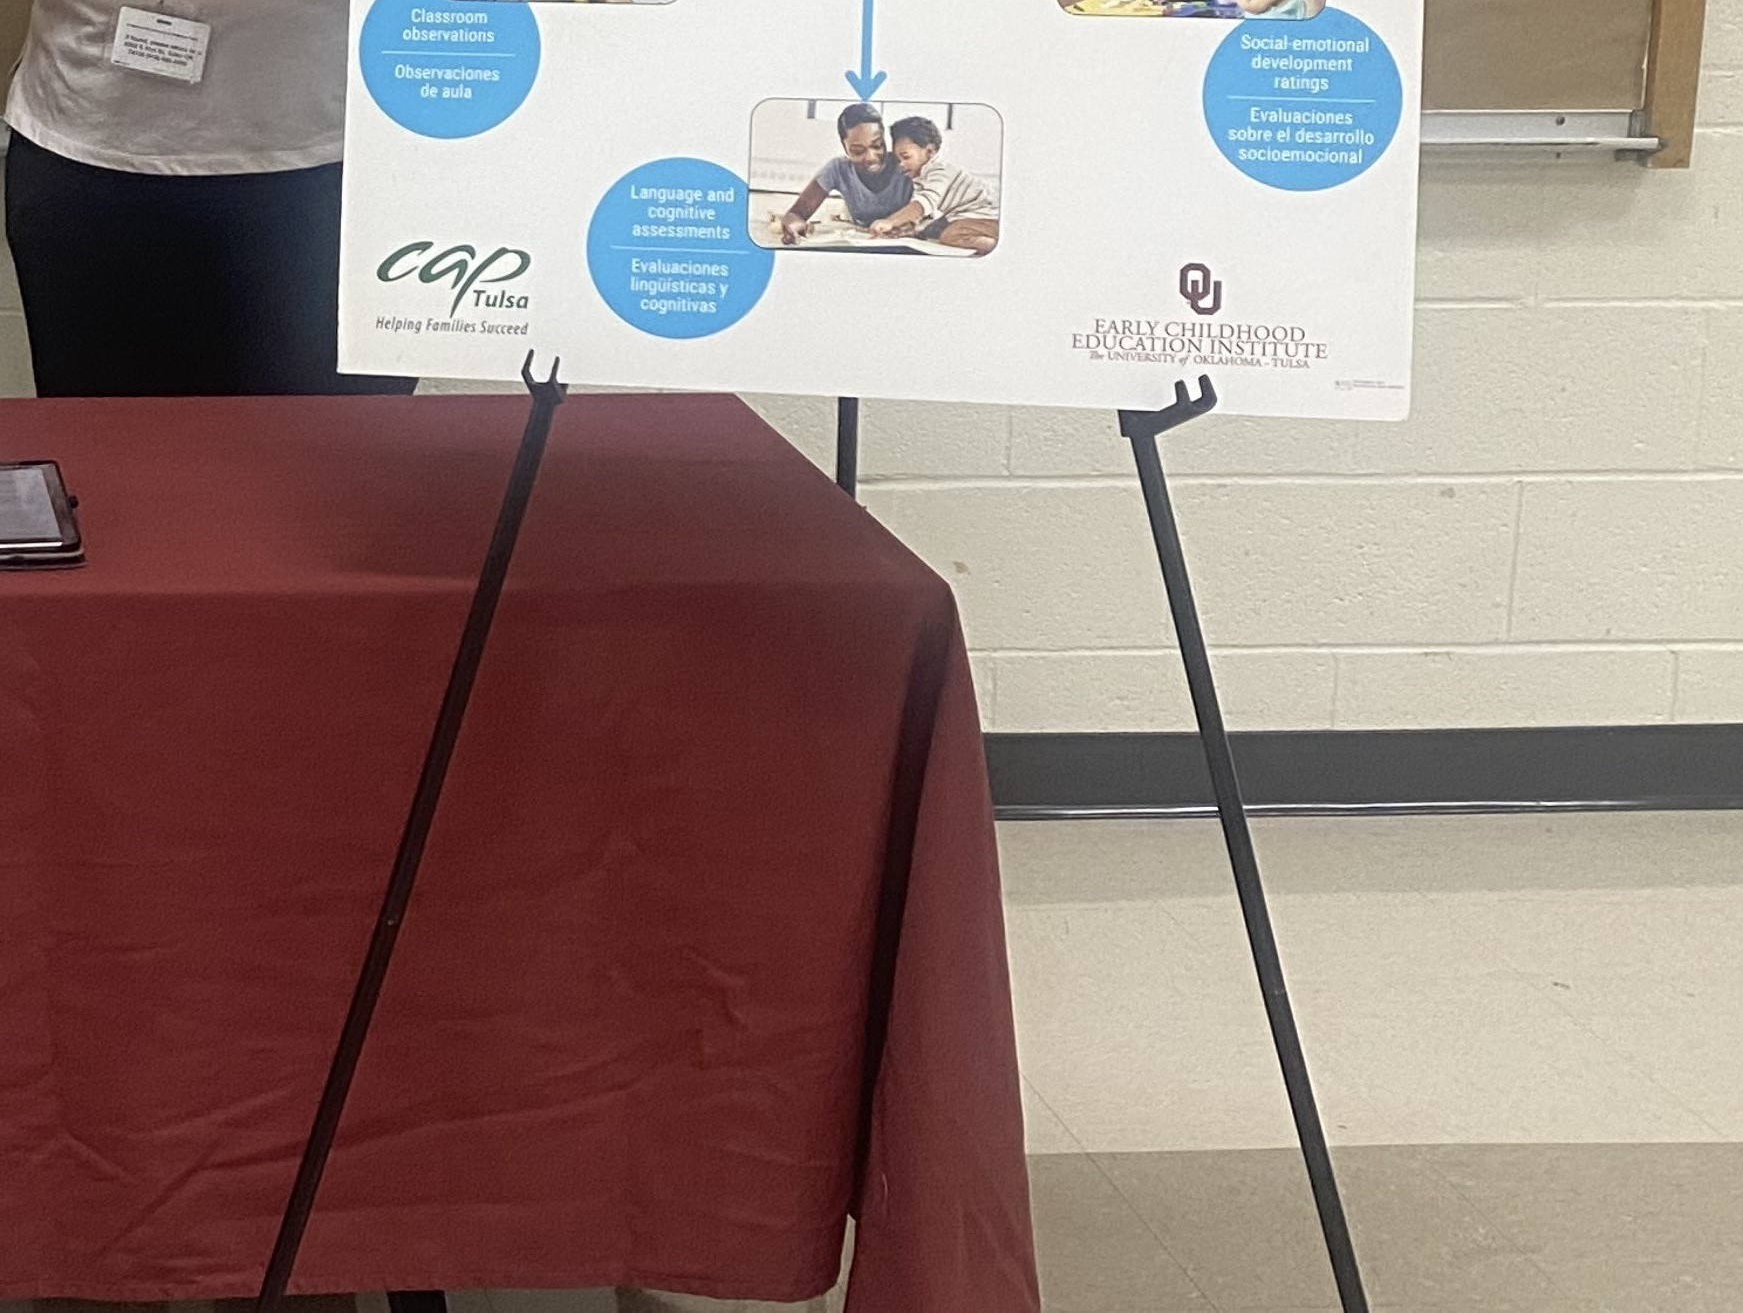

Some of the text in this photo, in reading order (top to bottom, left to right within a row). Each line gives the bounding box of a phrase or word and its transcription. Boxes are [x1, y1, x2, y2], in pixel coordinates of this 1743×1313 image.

[411, 7, 488, 24] Classroom
[402, 26, 495, 43] observations
[394, 63, 500, 82] Observaciones
[1251, 53, 1353, 73] development
[420, 82, 473, 99] de aula
[1274, 75, 1329, 94] ratings
[1250, 106, 1353, 125] Evaluaciones
[1228, 125, 1375, 146] sobre el desarrollo
[1238, 147, 1363, 165] socioemocional
[630, 184, 735, 205] Language and
[647, 206, 717, 223] cognitive
[632, 224, 731, 240] assessments
[631, 257, 729, 277] Evaluaciones
[630, 276, 729, 299] lingüísticas y
[1179, 262, 1222, 316] OU
[472, 289, 529, 310] Tulsa
[640, 296, 717, 315] cognitivas
[375, 316, 529, 336] Helping Families Succeed
[1093, 318, 1306, 343] EARLY CHILDHOOD
[1071, 333, 1328, 359] EDUCATION INSTITUTE
[1089, 350, 1105, 361] The
[1106, 350, 1178, 365] UNIVERSITY
[1178, 355, 1192, 367] of
[1193, 353, 1262, 368] OKLAHOMA
[1271, 356, 1311, 369] TULSA
